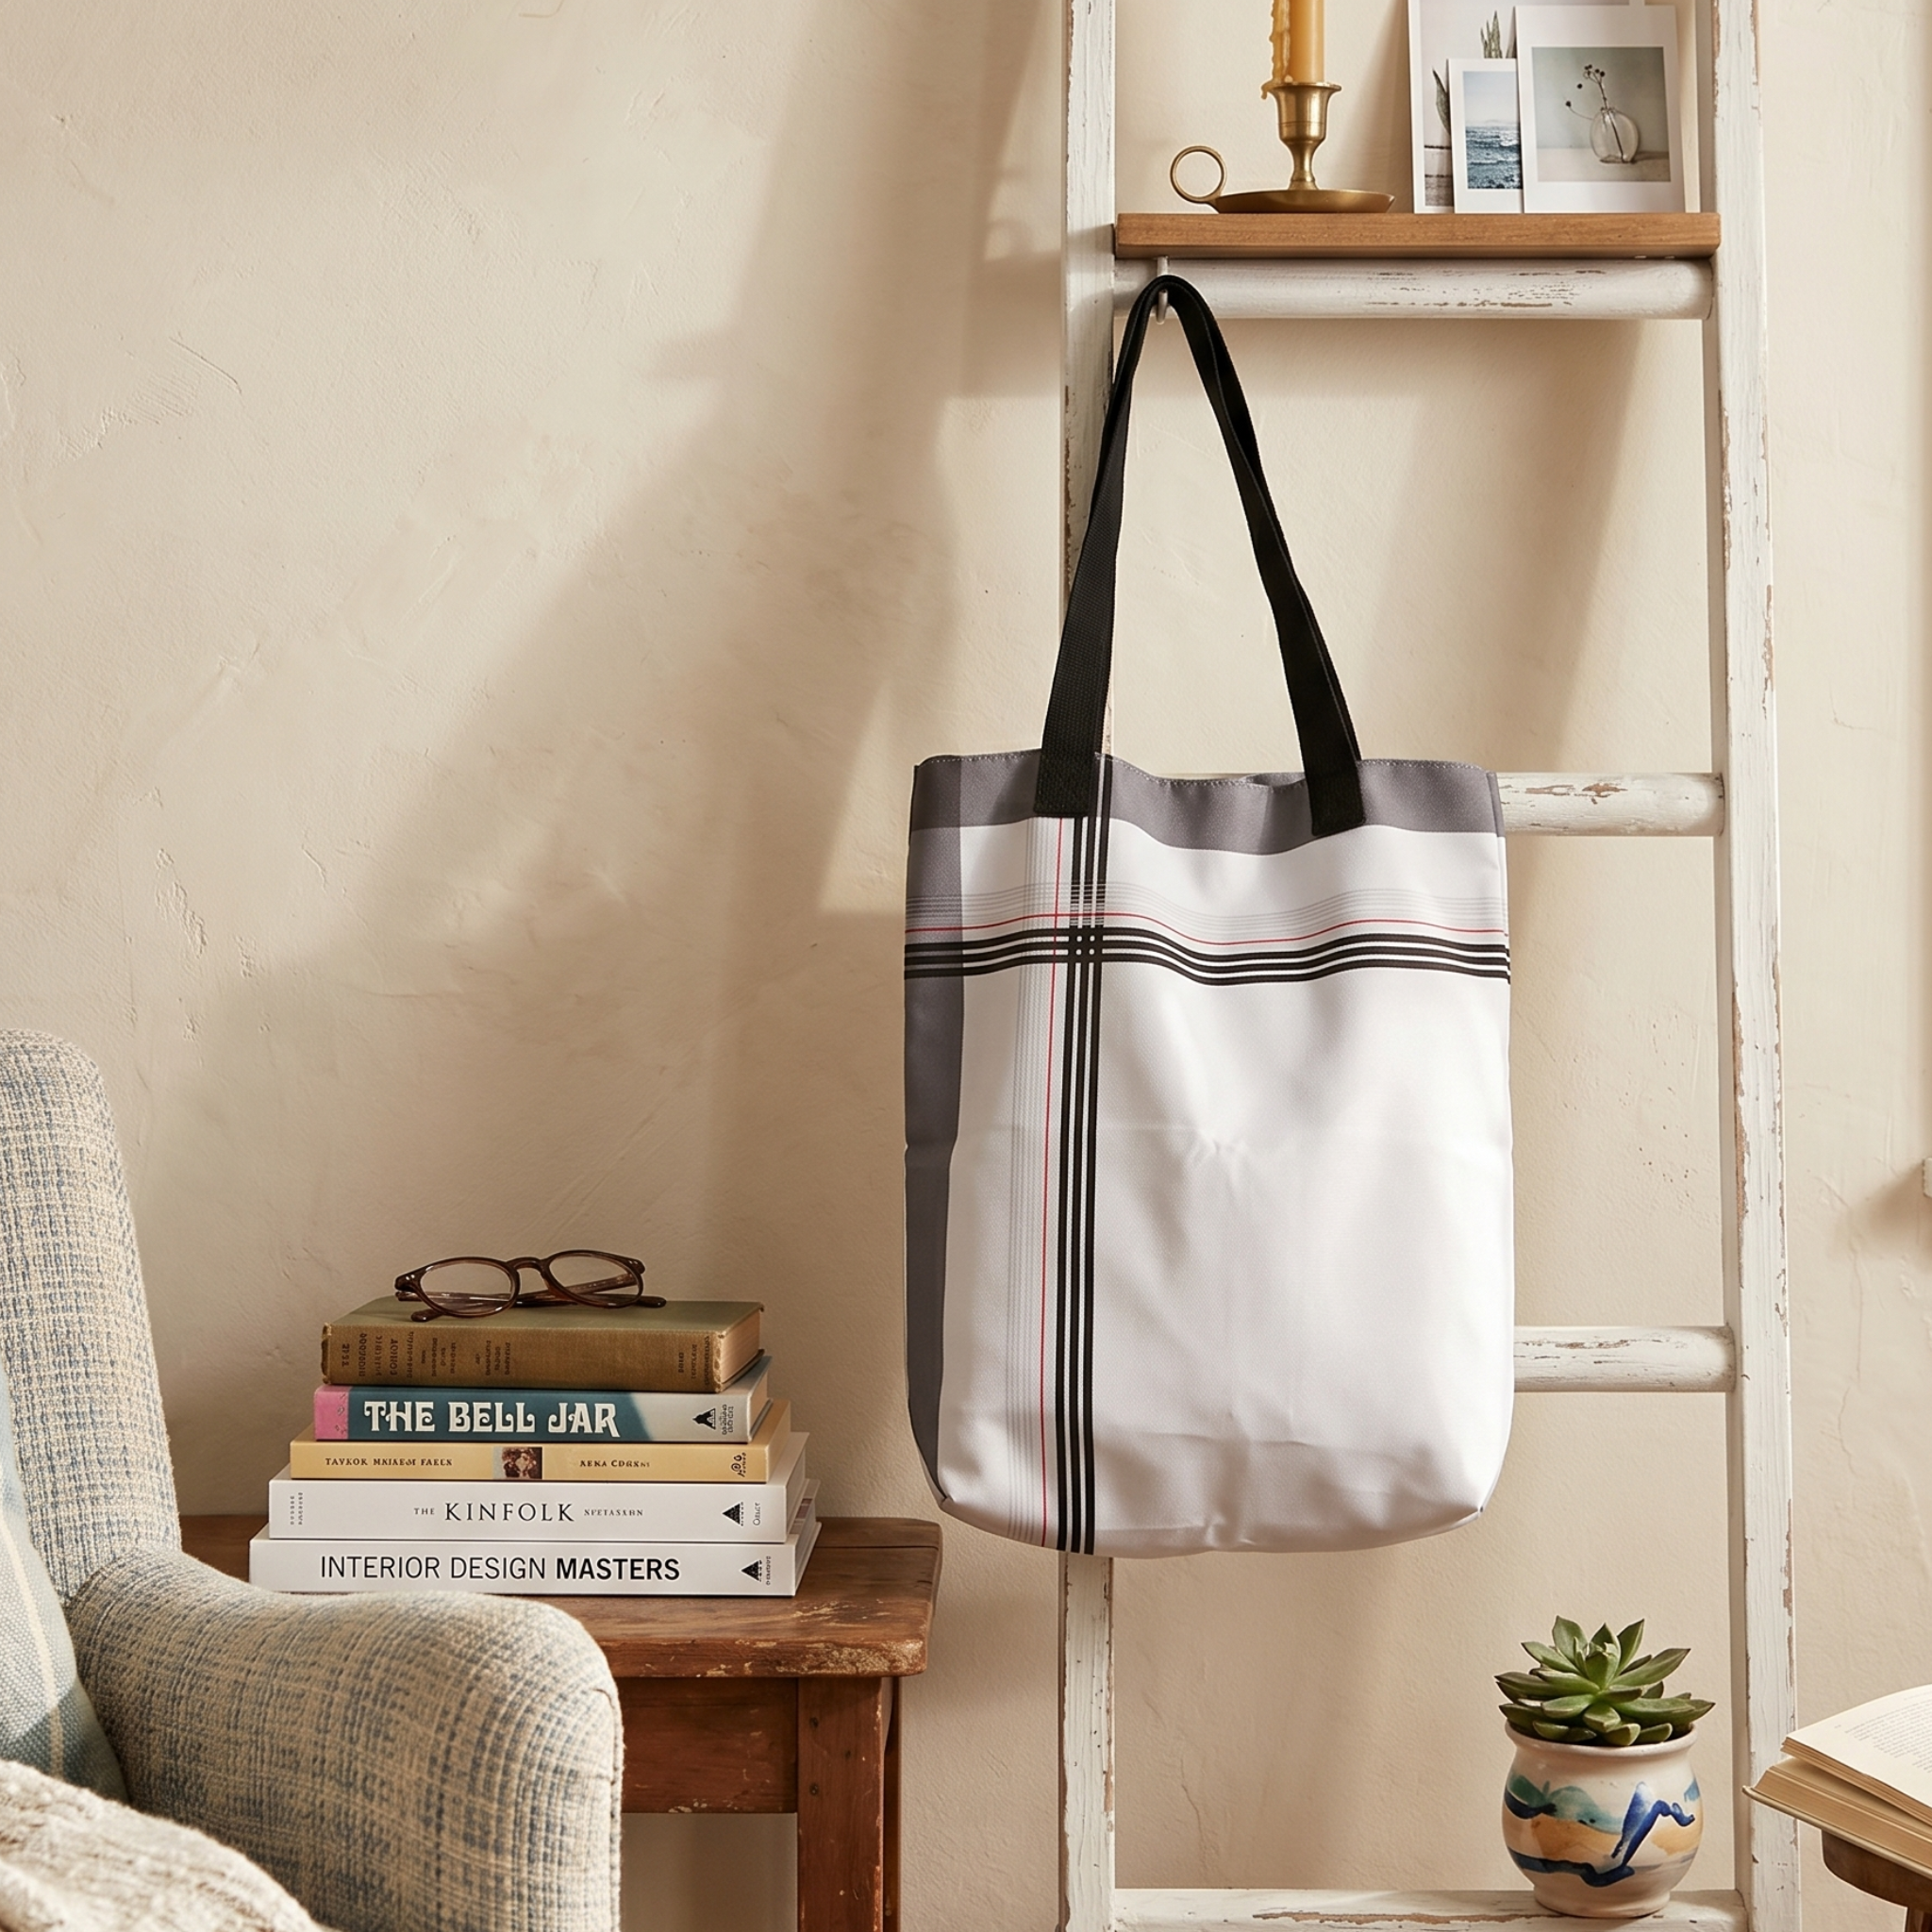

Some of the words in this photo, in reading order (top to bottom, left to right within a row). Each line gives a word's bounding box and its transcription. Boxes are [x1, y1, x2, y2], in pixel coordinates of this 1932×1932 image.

[364, 1401, 435, 1432] THE
[448, 1402, 536, 1433] BELL
[548, 1403, 621, 1438] JAR
[444, 1503, 575, 1522] KINFOLK
[321, 1557, 441, 1579] INTERIOR
[451, 1557, 545, 1580] DESIGN
[556, 1557, 680, 1581] MASTERS
